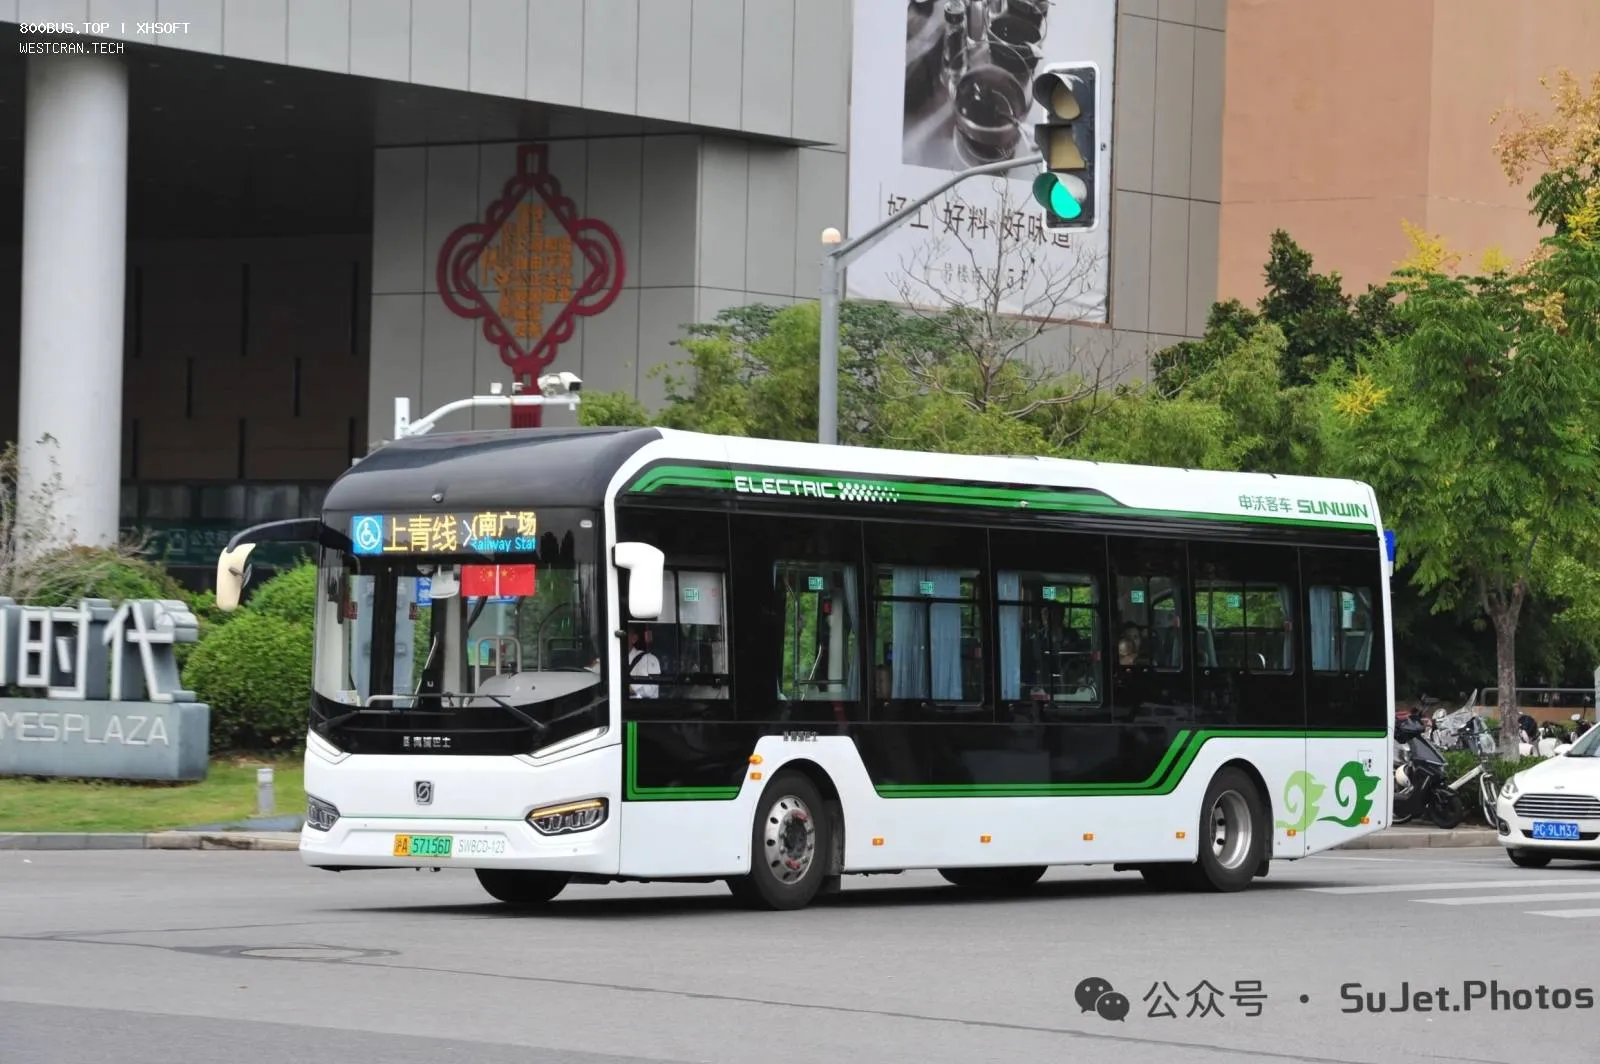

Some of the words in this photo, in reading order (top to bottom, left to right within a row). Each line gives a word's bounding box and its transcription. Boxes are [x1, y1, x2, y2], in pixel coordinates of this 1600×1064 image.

[943, 201, 987, 240] 好料
[734, 476, 836, 499] ELECTRIC
[1239, 494, 1293, 513] 申沃客车
[1297, 499, 1369, 518] SUNWIN
[383, 515, 457, 552] 上青线
[0, 598, 175, 703] 时代
